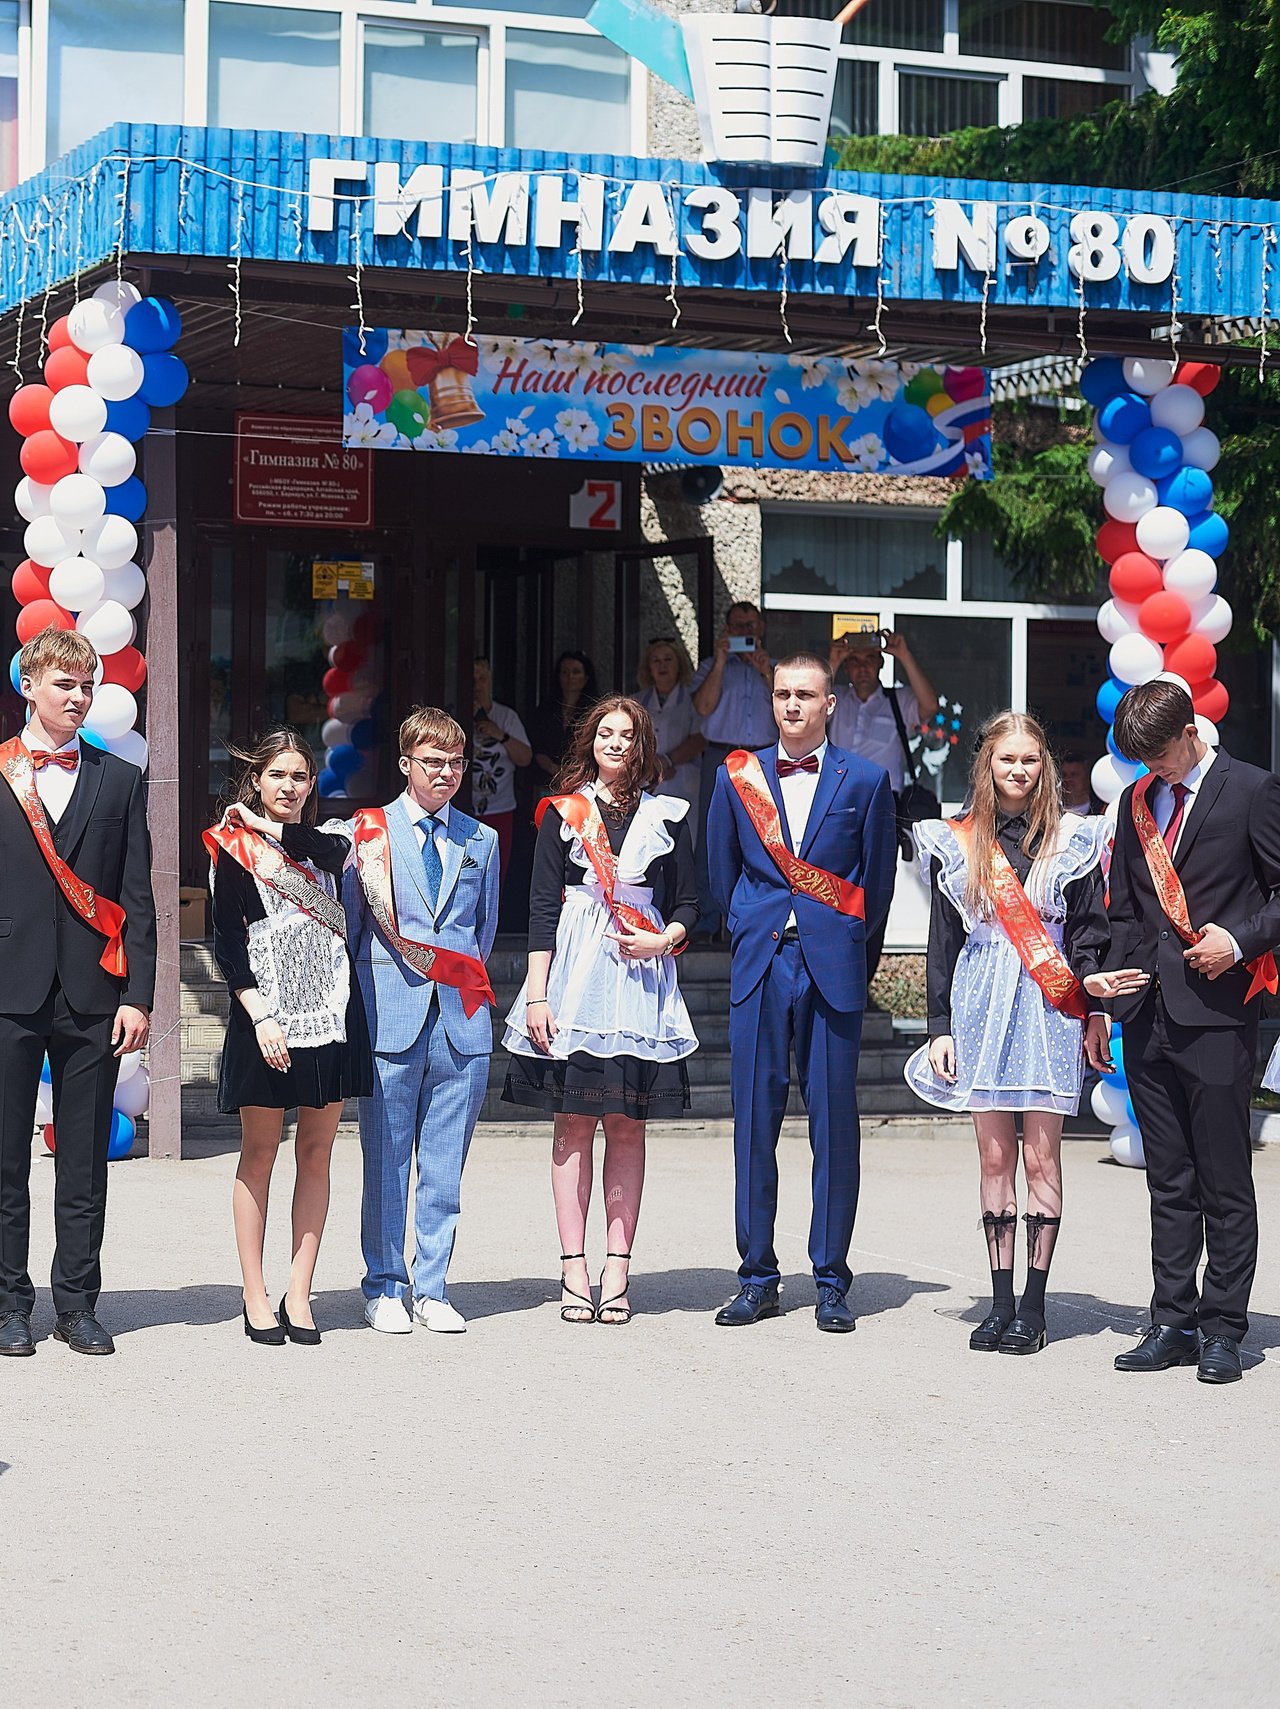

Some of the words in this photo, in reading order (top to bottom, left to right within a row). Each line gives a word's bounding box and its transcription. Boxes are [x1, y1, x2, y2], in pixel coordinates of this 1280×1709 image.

[307, 158, 880, 267] ГИМНАЗИЯ
[1067, 210, 1176, 284] 80
[492, 356, 578, 396] Наш
[583, 363, 773, 411] последний
[243, 448, 320, 468] «Гимназия
[322, 453, 340, 470] №
[342, 453, 364, 470] 80»
[603, 402, 856, 463] ЗВОНОК
[587, 482, 616, 529] 2
